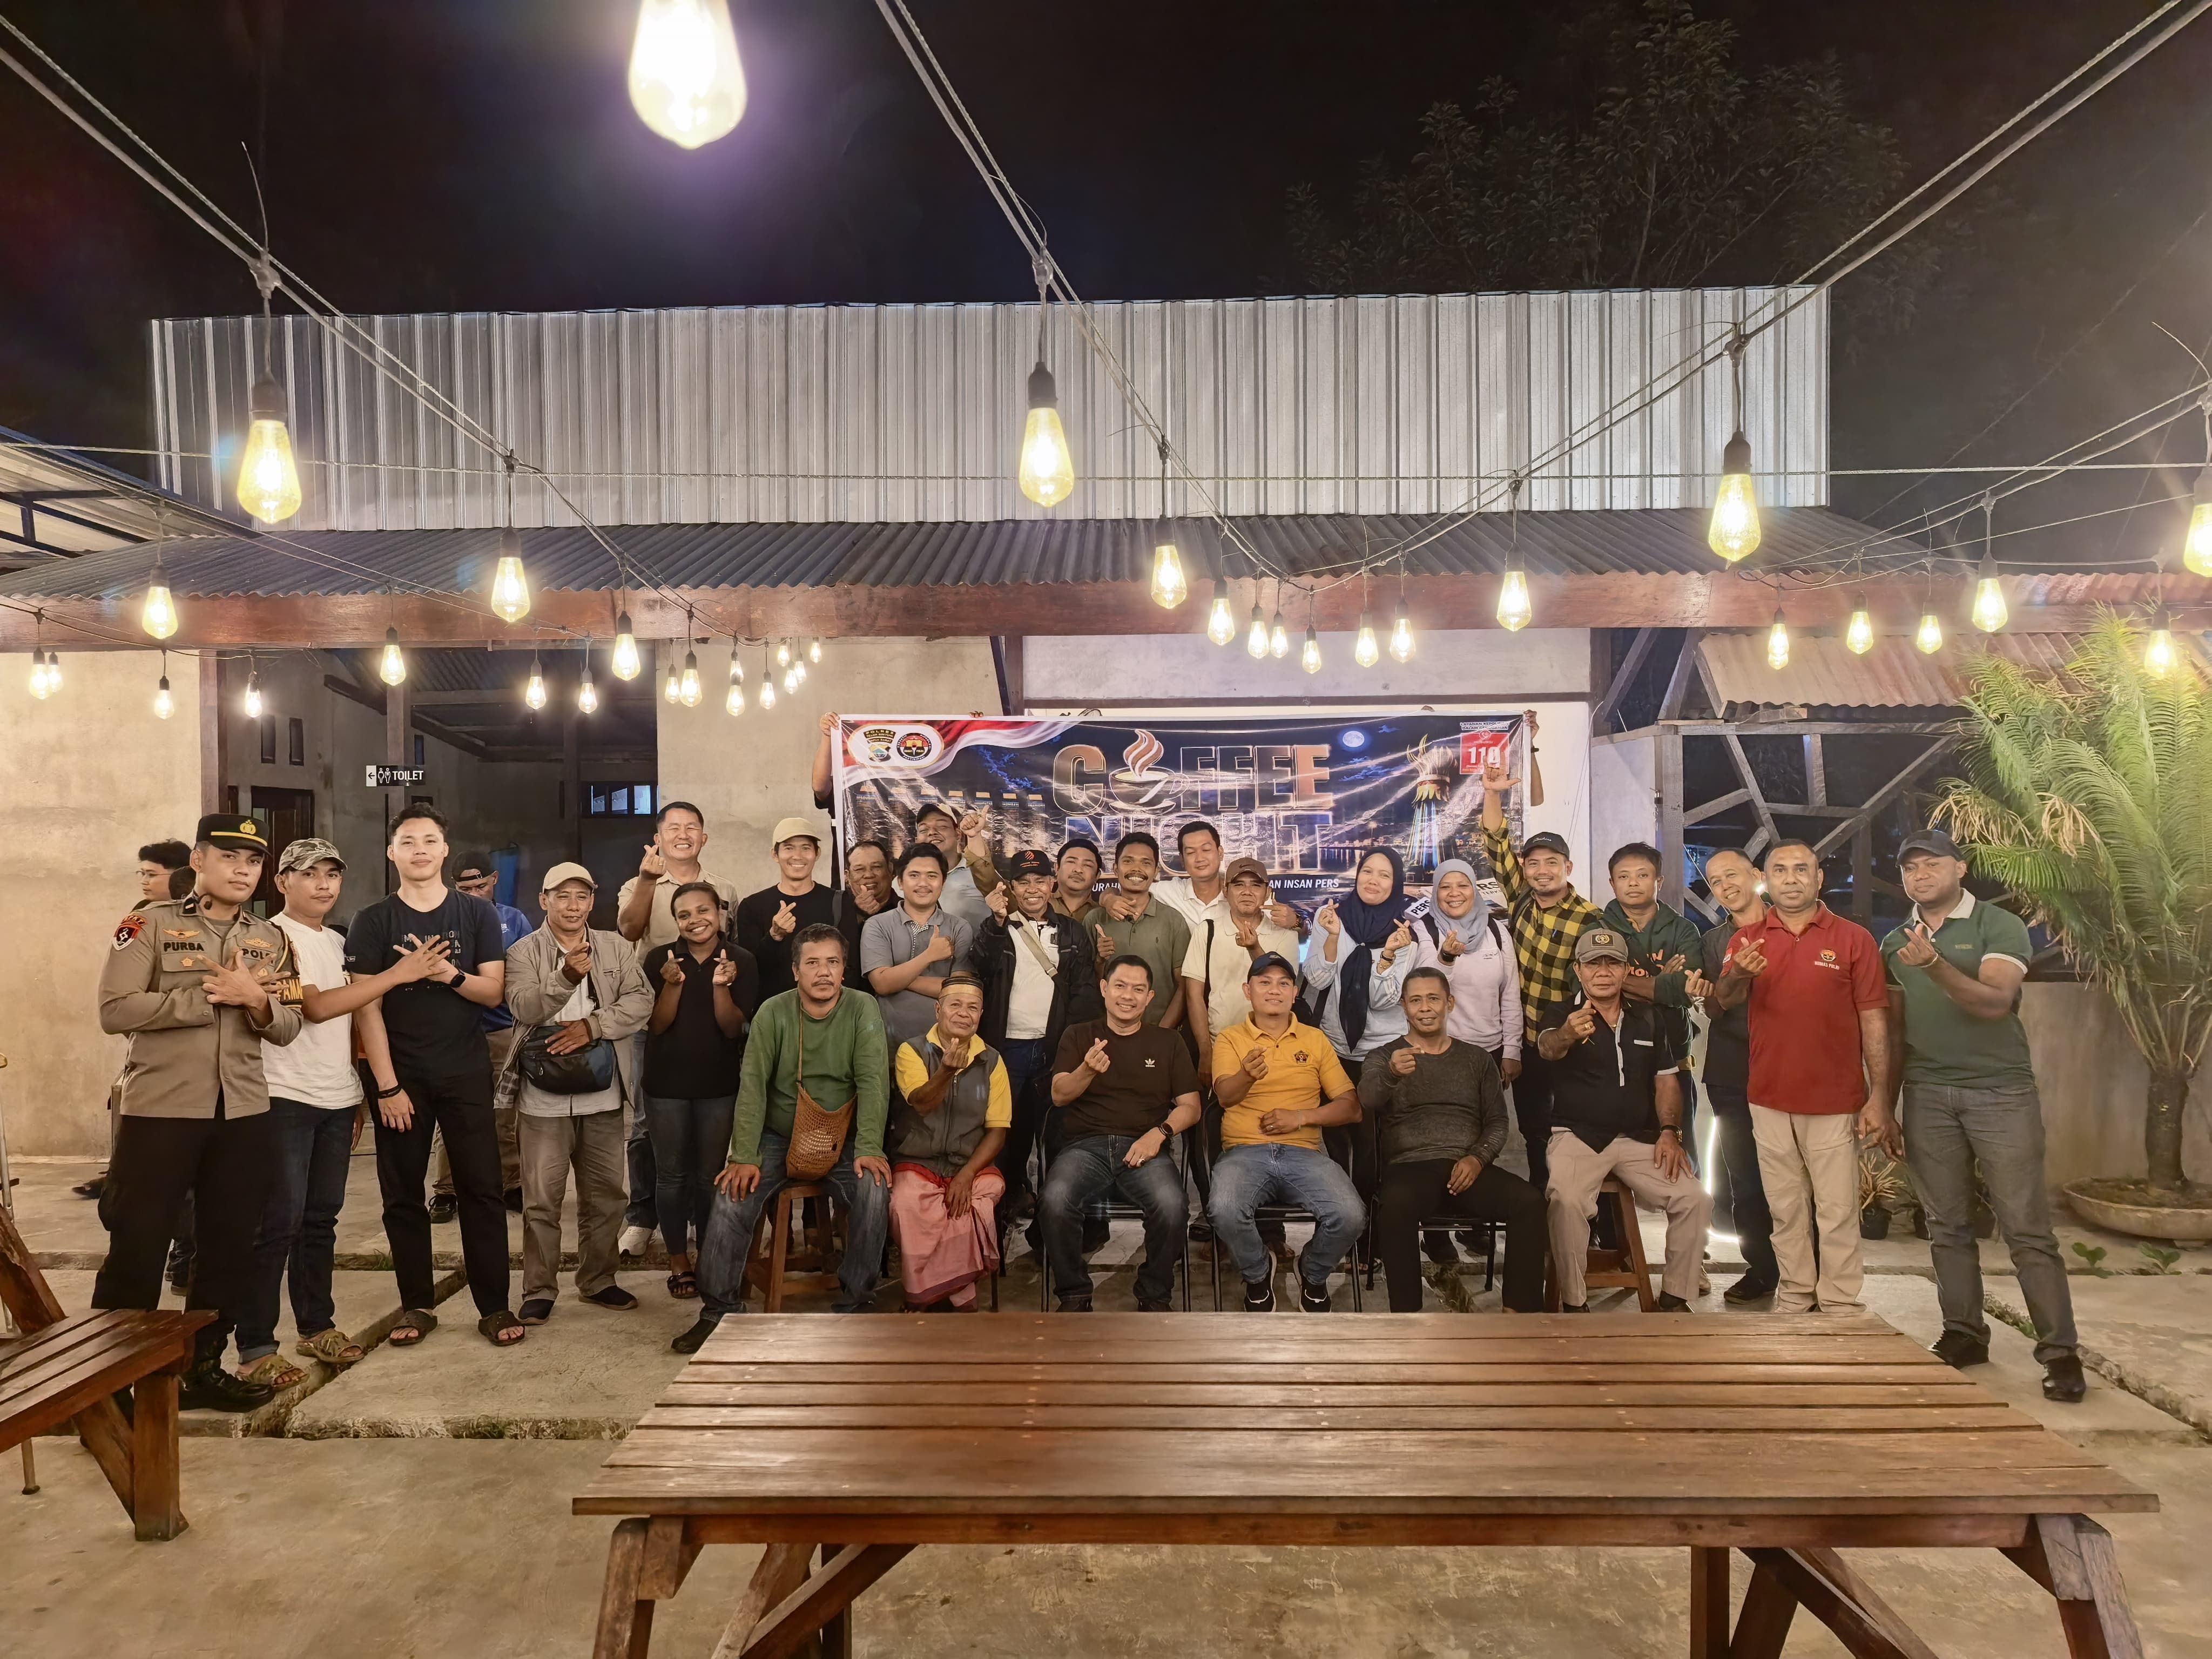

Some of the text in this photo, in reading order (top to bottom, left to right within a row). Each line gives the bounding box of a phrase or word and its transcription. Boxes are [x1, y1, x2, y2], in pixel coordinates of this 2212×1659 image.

[1468, 746, 1500, 764] 110
[392, 770, 424, 781] TOILET
[1284, 879, 1313, 888] INSAN
[1315, 878, 1340, 888] PERS
[164, 941, 204, 952] PURBA
[241, 948, 274, 964] POL
